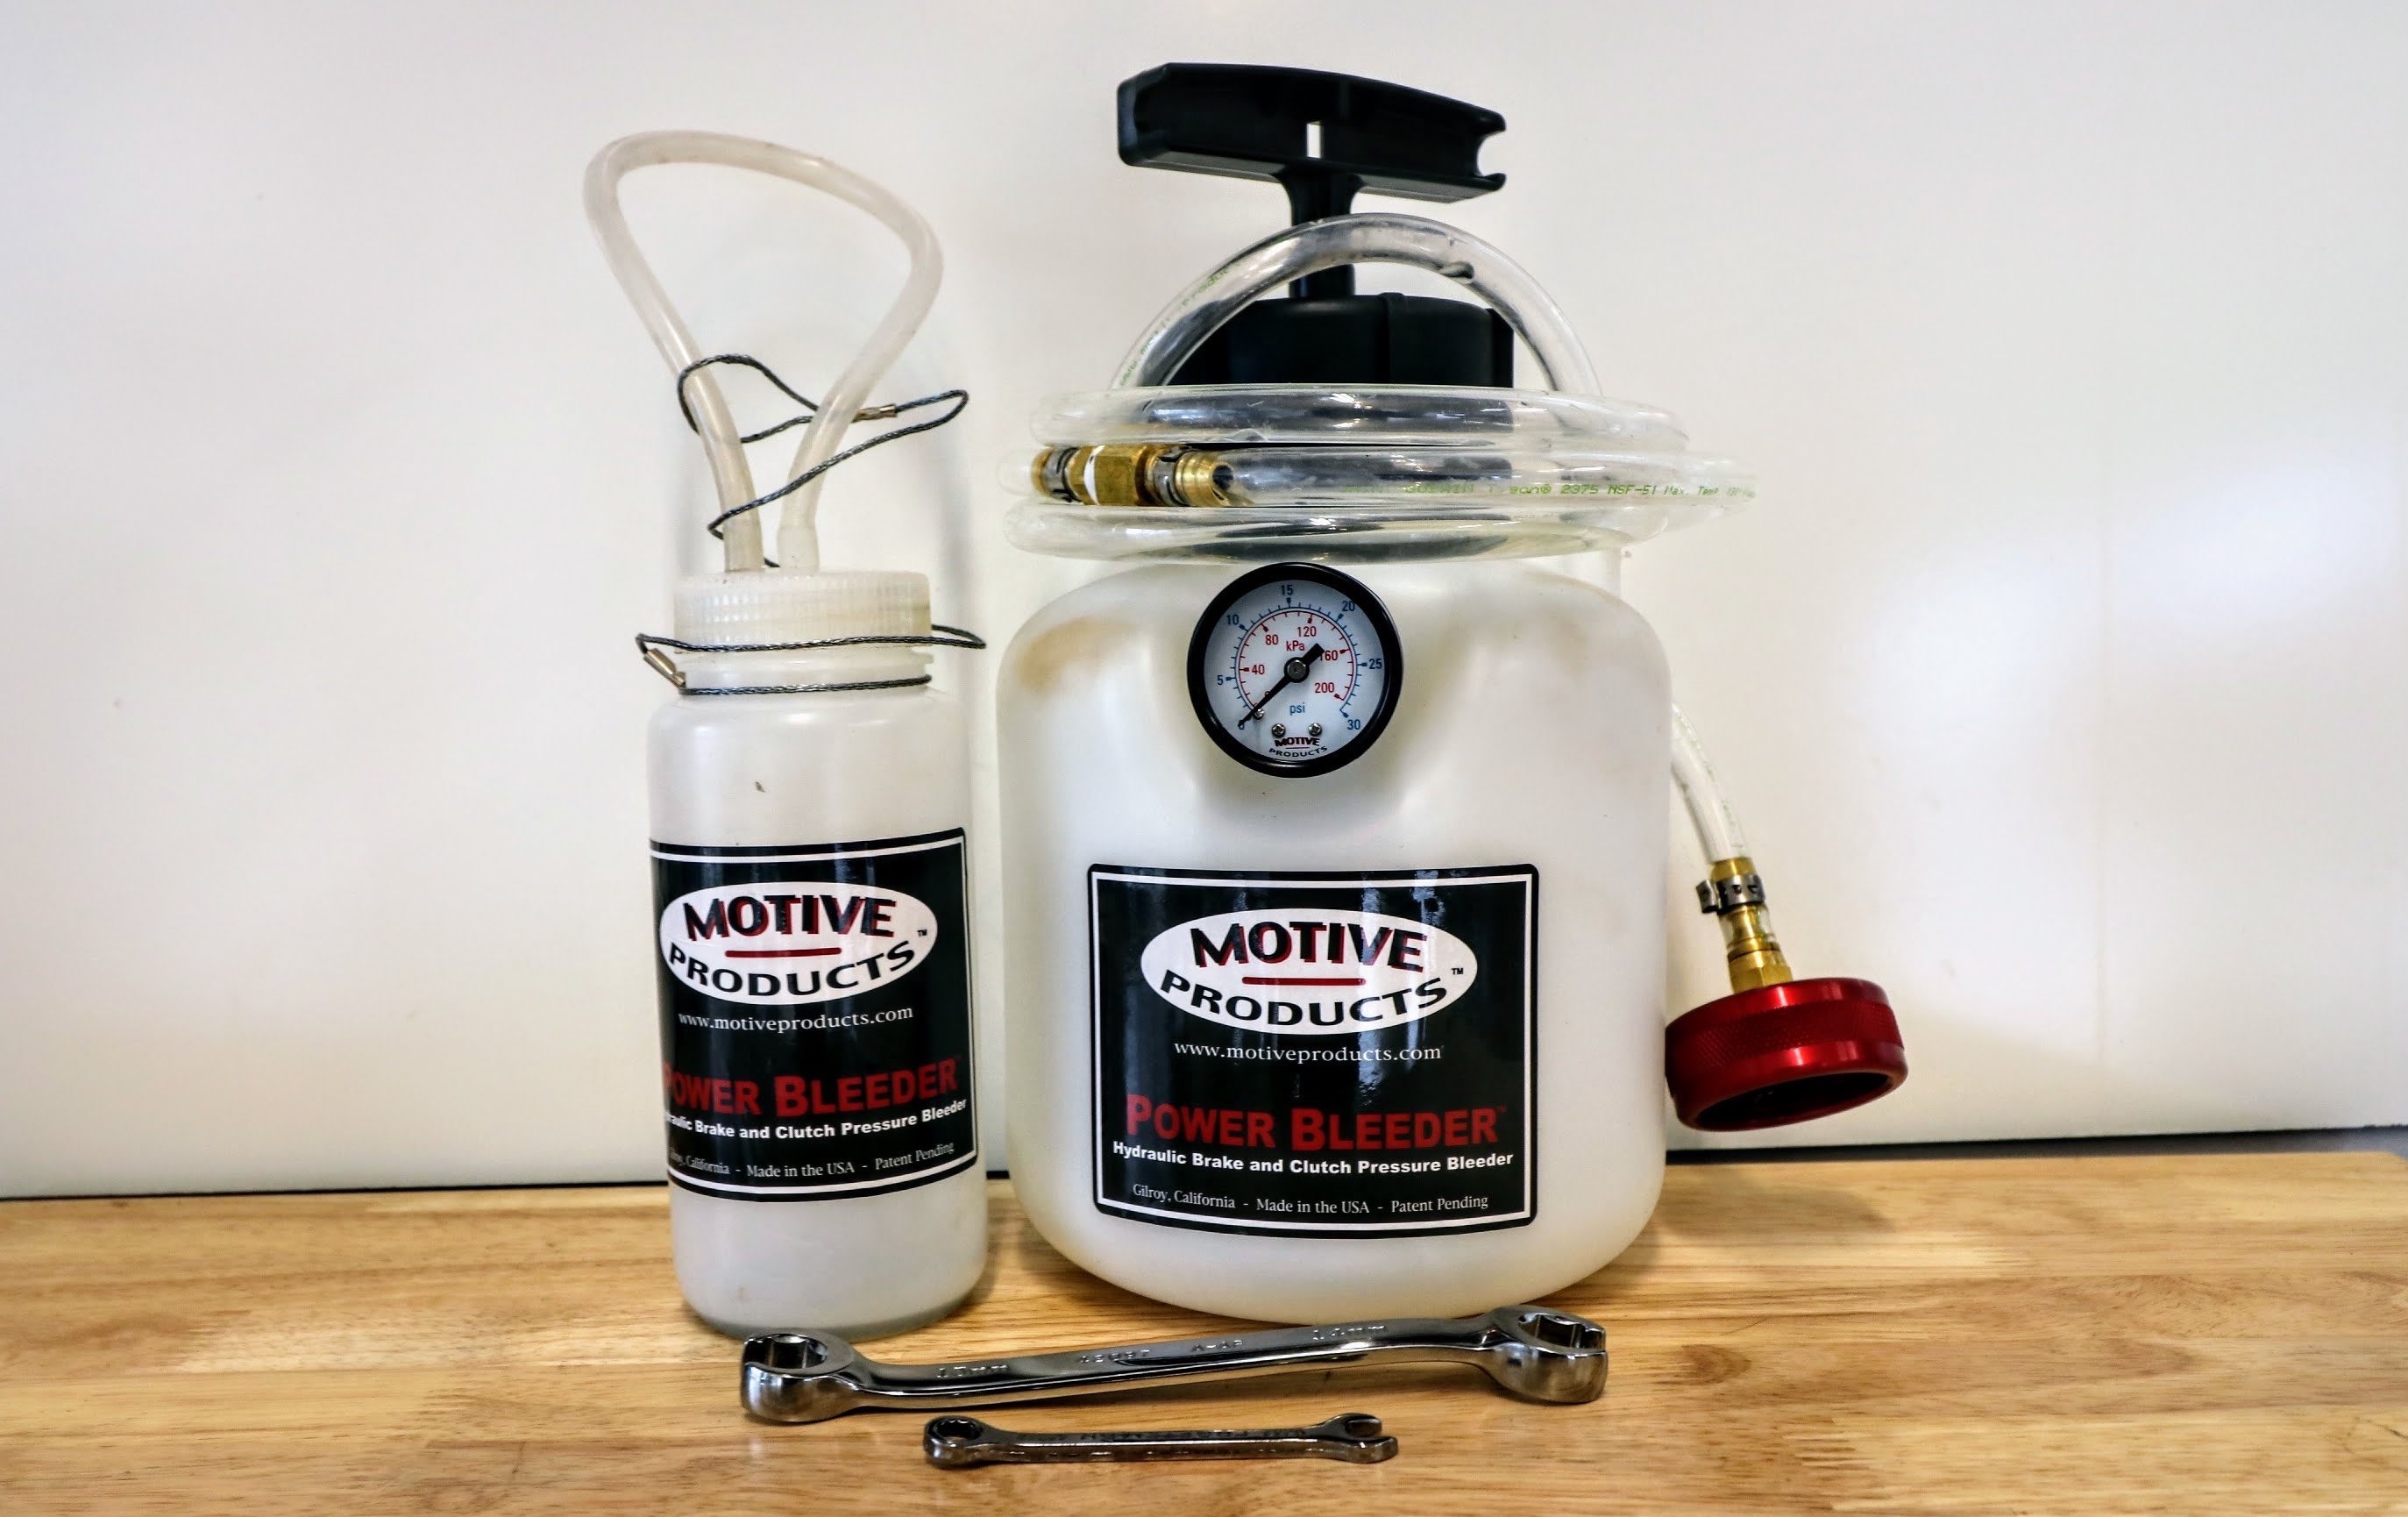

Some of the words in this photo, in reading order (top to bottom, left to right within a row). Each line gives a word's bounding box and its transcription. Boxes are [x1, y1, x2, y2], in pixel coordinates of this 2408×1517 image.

[1560, 484, 1599, 495] 2375
[1608, 484, 1656, 495] NSF-51
[1281, 585, 1294, 595] 15
[1342, 601, 1355, 611] 20
[1226, 614, 1240, 625] 10
[1297, 626, 1317, 637] 120
[1265, 635, 1278, 645] 80
[1286, 641, 1305, 652] kPa
[1252, 665, 1265, 675] 40
[1369, 659, 1382, 670] 25
[1217, 675, 1224, 686] 5
[1315, 682, 1334, 694] 200
[1289, 702, 1305, 716] psi
[1347, 720, 1360, 730] 30
[1275, 737, 1320, 747] MOTIVE
[1268, 746, 1328, 758] PRODUCTS
[683, 894, 897, 942] MOTIVE
[1190, 921, 1428, 972] MOTIVE
[670, 940, 915, 996] PRODUCTS
[1161, 969, 1448, 1026] PRODUCTS
[678, 1008, 913, 1034] www.motiveproducts.com
[1175, 1041, 1442, 1064] www.motiveproducts.com
[774, 1057, 959, 1118] BLEEDER
[694, 1120, 735, 1137] Brake
[739, 1126, 771, 1139] and
[775, 1124, 835, 1139] Clutch
[841, 1115, 918, 1136] Pressure
[921, 1099, 967, 1122] Bleeder
[1126, 1093, 1276, 1149] POWER
[1291, 1107, 1499, 1151] BLEEDER
[685, 1155, 730, 1175] California
[747, 1164, 781, 1177] Made
[785, 1165, 798, 1177] in
[801, 1164, 824, 1177] the
[827, 1162, 855, 1175] USA
[875, 1154, 913, 1171] Patent
[915, 1143, 955, 1162] Pending
[1113, 1141, 1187, 1164] Hydraulic
[1192, 1152, 1244, 1170] Brake
[1249, 1159, 1283, 1172] and
[1289, 1159, 1352, 1173] Clutch
[1358, 1160, 1441, 1174] Pressure
[1446, 1153, 1514, 1171] Bleeder
[1133, 1183, 1171, 1203] Gilroy,
[1174, 1190, 1236, 1209] California
[1256, 1198, 1293, 1212] Made
[1297, 1200, 1311, 1213] in
[1315, 1200, 1338, 1214] the
[1341, 1200, 1370, 1214] USA
[1391, 1200, 1433, 1213] Patent
[1438, 1195, 1488, 1211] Pending
